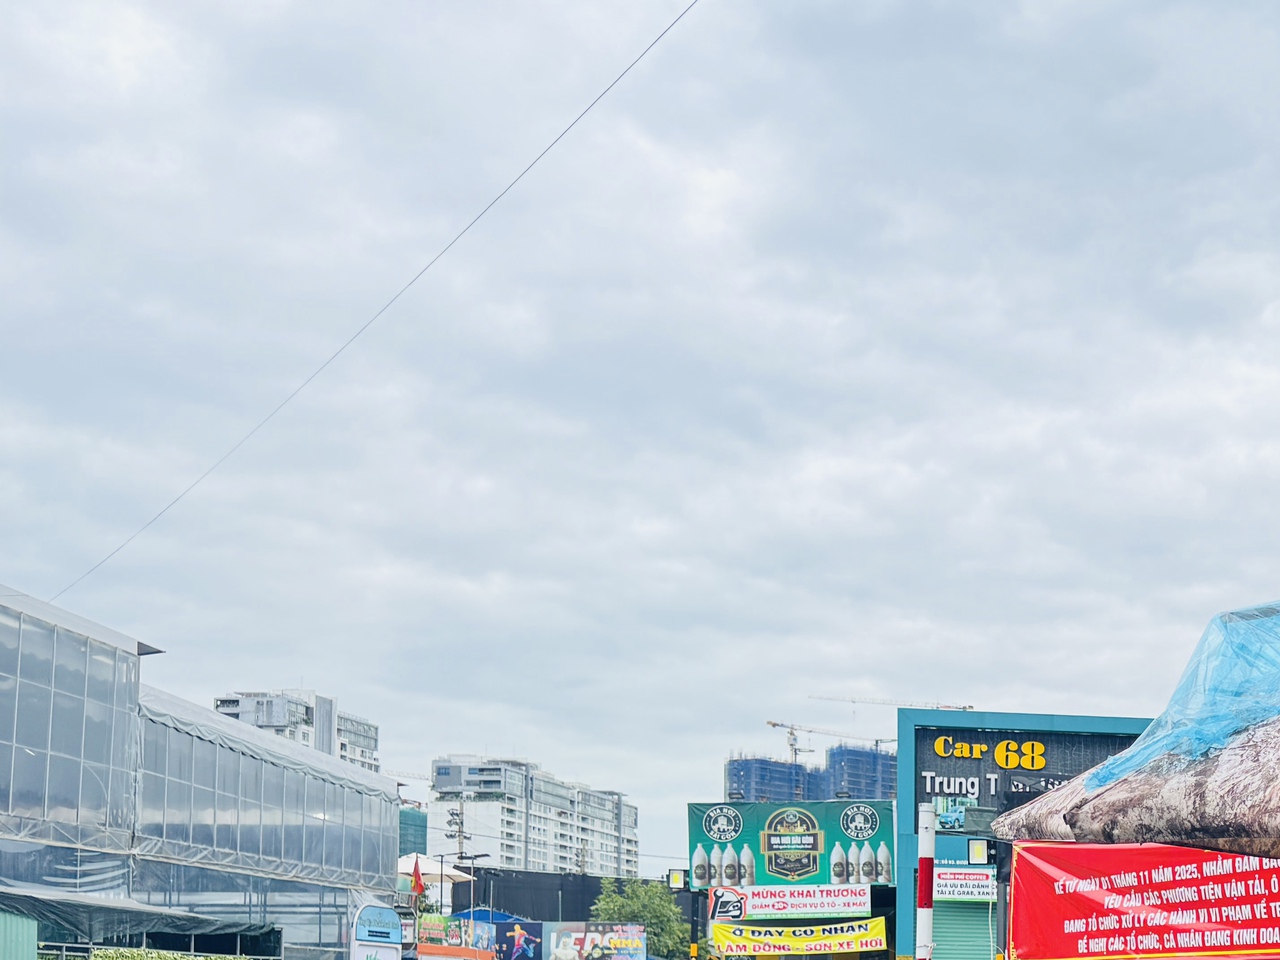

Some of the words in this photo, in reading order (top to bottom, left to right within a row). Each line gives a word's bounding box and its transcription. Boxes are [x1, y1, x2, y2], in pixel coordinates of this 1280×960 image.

[934, 736, 988, 759] Car
[994, 740, 1046, 770] 68
[921, 771, 979, 798] Trung
[1077, 876, 1100, 892] NGÀY
[1101, 877, 1112, 890] 01
[1111, 871, 1138, 888] THÁNG
[1139, 870, 1149, 885] 11
[1152, 865, 1173, 884] NĂM
[1175, 864, 1201, 880] 2025,
[751, 888, 786, 899] MỪNG
[789, 890, 816, 899] KHAI
[819, 888, 867, 898] TRƯƠNG
[1104, 893, 1121, 909] YÊU
[1123, 889, 1141, 908] CẦU
[1143, 889, 1161, 906] CÁC
[1161, 886, 1199, 904] PHƯƠNG
[1200, 882, 1222, 902] TIỆN
[1224, 879, 1246, 900] VẬN
[1248, 874, 1269, 896] TẢI,
[1270, 874, 1279, 893] Ô
[790, 902, 807, 910] DỊCH
[1064, 918, 1086, 933] ĐANG
[1135, 911, 1147, 927] LÝ
[1147, 910, 1168, 926] CÁC
[1168, 908, 1196, 925] HÀNH
[1198, 907, 1208, 923] VI
[1210, 908, 1220, 922] VI
[1222, 904, 1252, 924] PHẠM
[1253, 898, 1268, 919] VỀ
[610, 939, 643, 948] MMA
[838, 941, 854, 950] XE
[1089, 937, 1107, 954] NGHỊ
[1108, 934, 1124, 951] CÁC
[1164, 930, 1176, 948] CÁ
[1177, 929, 1202, 948] NHÂN
[1204, 930, 1231, 946] ĐANG
[1233, 928, 1257, 945] KINH
